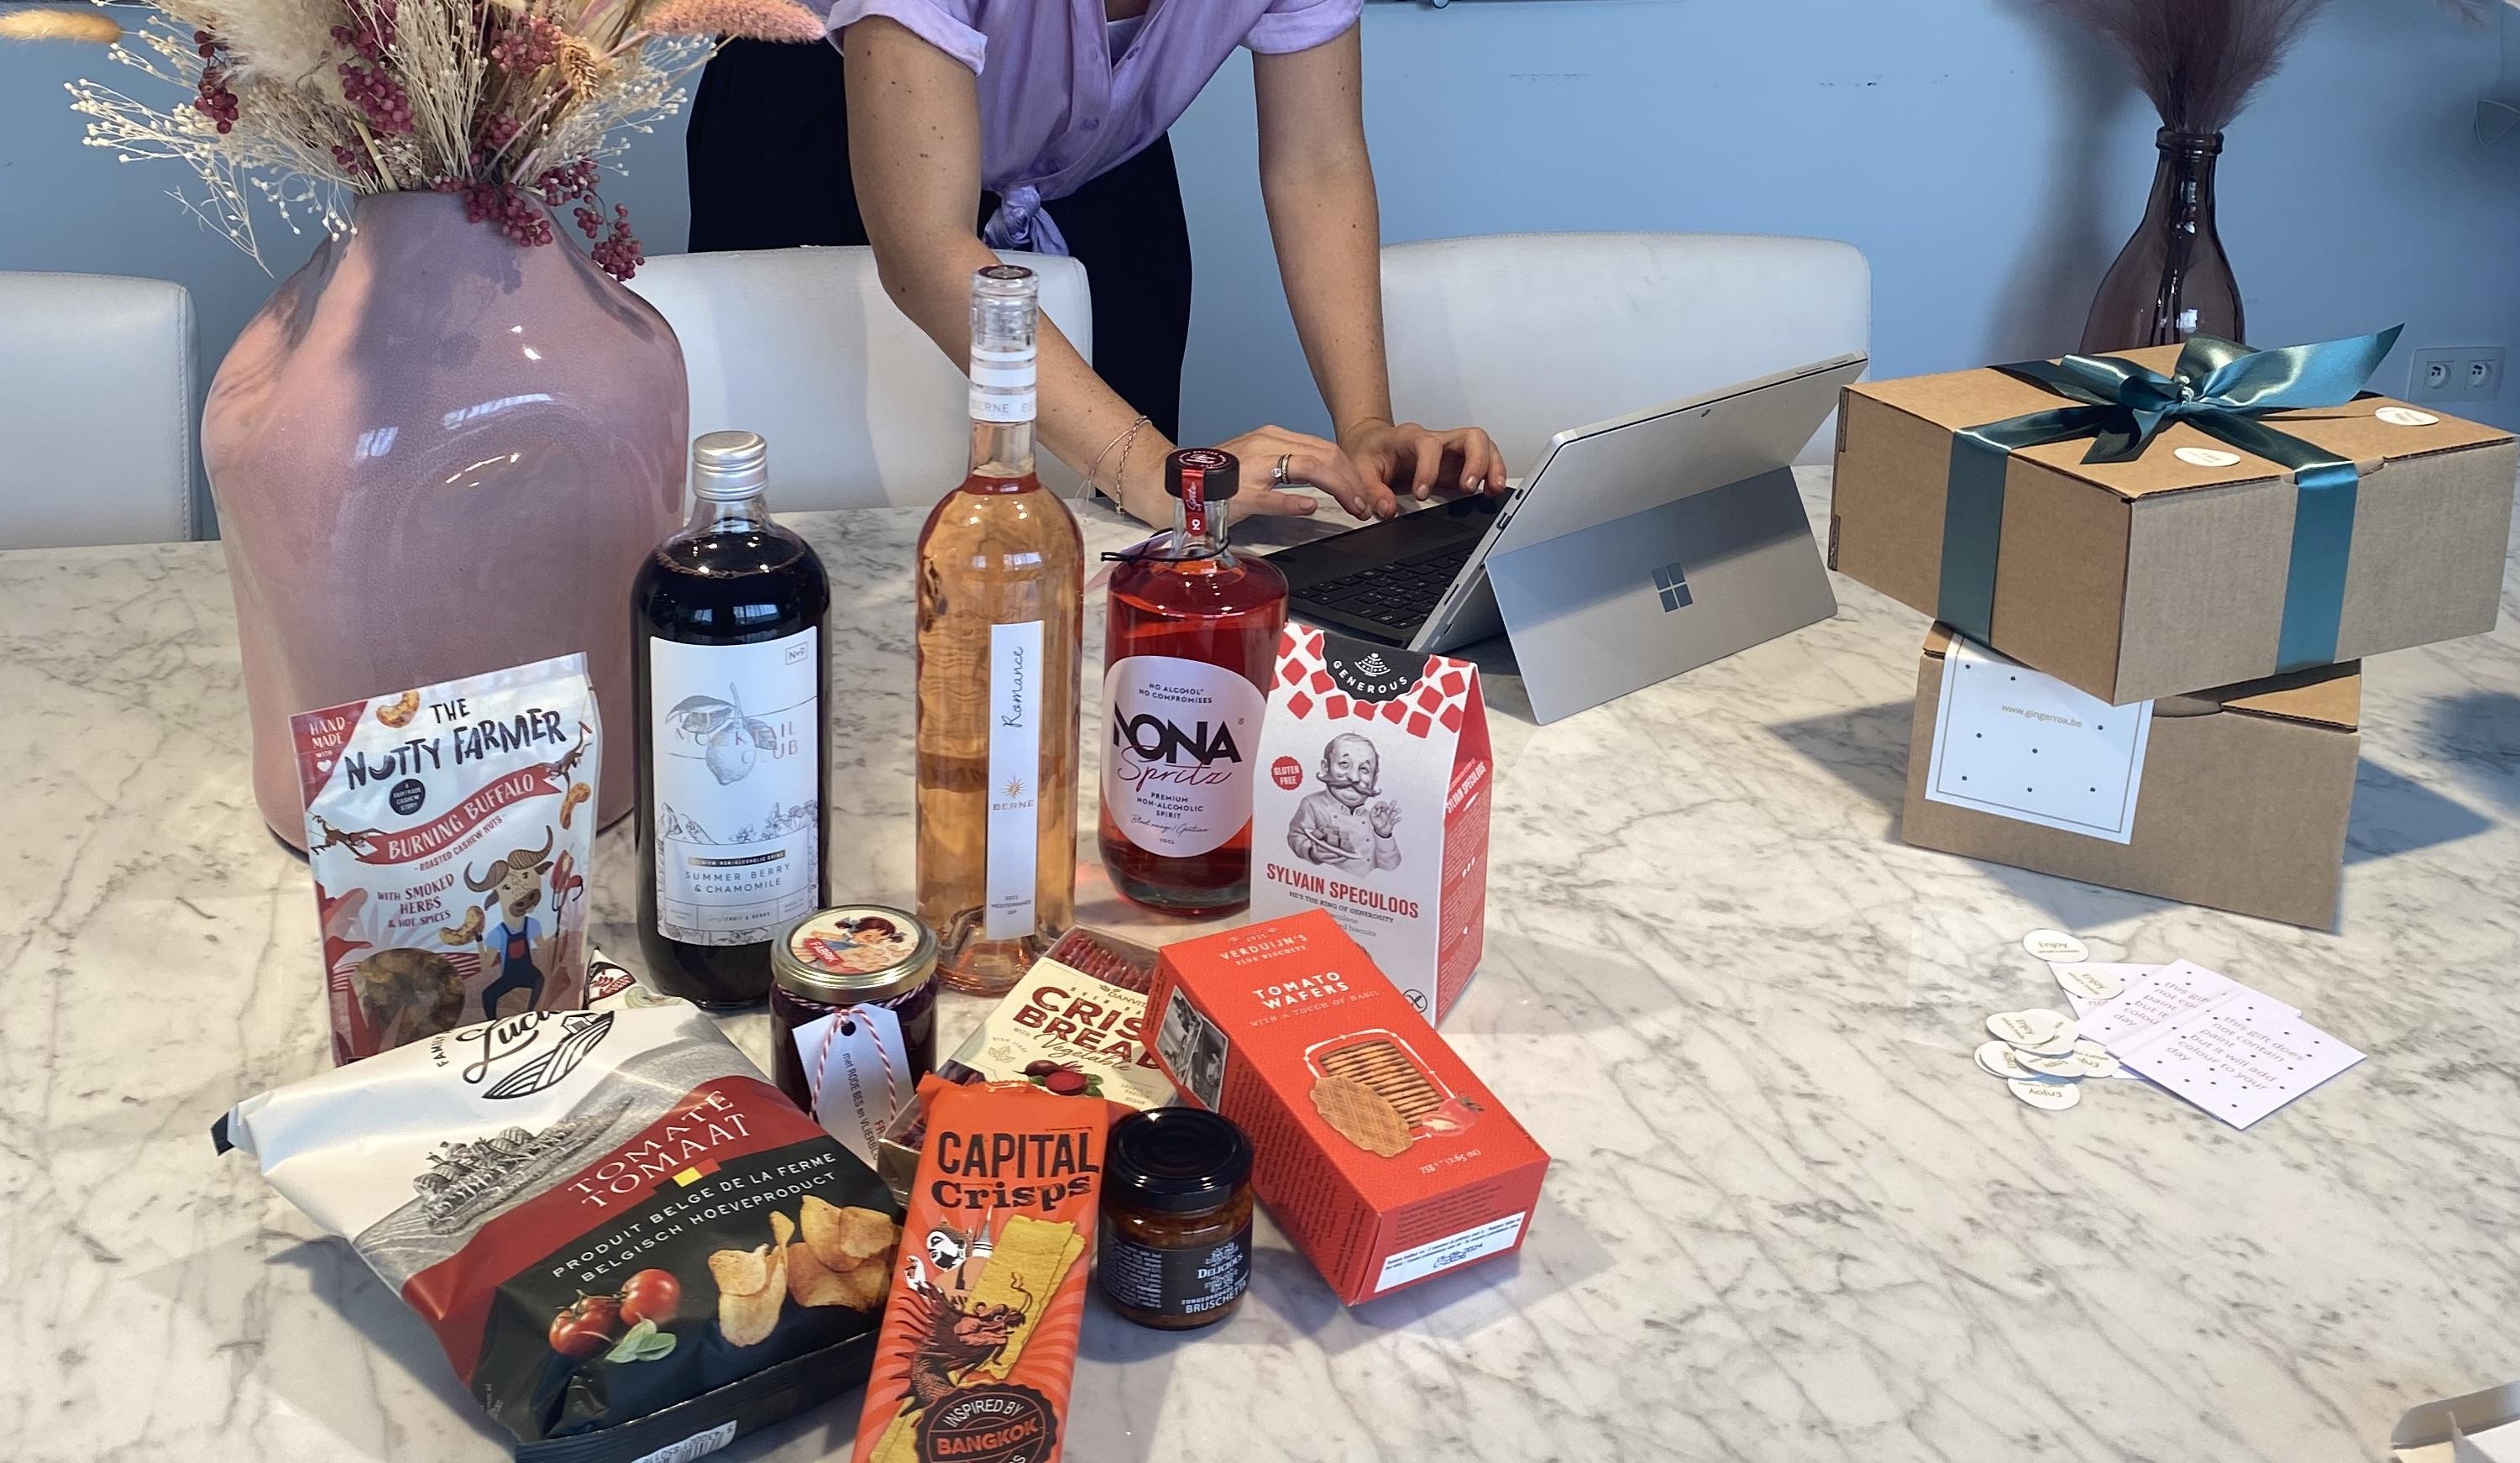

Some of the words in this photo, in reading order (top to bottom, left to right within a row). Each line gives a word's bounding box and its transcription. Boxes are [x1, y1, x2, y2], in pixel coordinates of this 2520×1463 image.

[1001, 646, 1024, 728] Romance
[1149, 683, 1161, 691] NO
[1333, 660, 1407, 694] GENEROUS
[1139, 689, 1150, 697] NO
[1152, 693, 1213, 705] COMPROMISES
[430, 699, 471, 724] THE
[2002, 705, 2083, 727] www.gingerrox.be
[309, 716, 352, 736] HAND-
[312, 732, 344, 748] MADE
[344, 738, 441, 790] NUTTY
[453, 709, 567, 765] FARMER
[1118, 745, 1233, 792] Spritz
[1273, 765, 1300, 776] GLUTEN
[1280, 775, 1297, 785] FREE
[993, 800, 1035, 810] BERNE
[1137, 797, 1203, 812] NON-ALCOHOLIC
[1151, 792, 1188, 802] PREMIUM
[387, 814, 465, 860] BURNING
[464, 773, 535, 821] BUFFALO
[1156, 810, 1181, 819] SPIRIT
[419, 852, 453, 872] ROASTED
[453, 830, 484, 857] CASHEW
[484, 815, 503, 833] NUTS
[684, 871, 741, 881] SUMMER
[751, 863, 791, 878] BERRY
[377, 891, 401, 901] WITH
[406, 873, 454, 900] SMOKED
[694, 884, 702, 893] &
[705, 878, 782, 894] CHAMOMILE
[1266, 863, 1324, 894] SYLVAIN
[1329, 881, 1419, 919] SPECULOOS
[400, 896, 443, 915] HERBS
[421, 910, 451, 925] SPICES
[1305, 895, 1319, 905] THE
[1319, 899, 1338, 910] KING
[1349, 908, 1394, 923] GENEROSITY
[1218, 934, 1307, 960] VERDUIJN'S
[1252, 972, 1341, 1000] TOMATO
[1262, 981, 1349, 1009] WAFERS
[2154, 988, 2177, 1000] not
[2178, 999, 2198, 1008] co
[2165, 982, 2187, 994] this
[1108, 991, 1146, 1008] DANVIT
[1250, 1015, 1278, 1028] WITH
[1279, 1013, 1291, 1021] A
[1292, 1002, 1329, 1016] TOUCH
[1332, 998, 1346, 1006] OF
[1349, 989, 1381, 1003] BASIL
[2134, 1000, 2157, 1012] but
[2142, 994, 2177, 1010] paint
[1032, 987, 1145, 1041] CRIS
[2114, 1014, 2138, 1026] day
[2124, 1007, 2160, 1025] colou
[1013, 1027, 1031, 1037] WITH
[2199, 1029, 2235, 1047] paint
[2212, 1023, 2235, 1036] not
[2236, 1035, 2285, 1062] contain
[2224, 1016, 2247, 1031] this
[2246, 1030, 2271, 1043] gift
[2271, 1041, 2304, 1061] does
[842, 1052, 854, 1068] met
[1034, 1033, 1131, 1071] Vegetable
[2166, 1046, 2191, 1062] day
[2189, 1034, 2213, 1048] but
[2225, 1053, 2250, 1067] will
[2249, 1066, 2277, 1083] add
[2178, 1041, 2220, 1063] colour
[2220, 1062, 2235, 1072] to
[2234, 1072, 2270, 1090] your
[847, 1067, 861, 1092] RODE
[852, 1090, 865, 1108] BES
[2029, 1088, 2062, 1099] Enjoy
[567, 1090, 735, 1193] TOMATE
[860, 1117, 878, 1161] VLIERBLO
[581, 1113, 750, 1208] TOMAAT
[937, 1131, 1100, 1178] CAPITAL
[931, 1175, 1092, 1212] Crisps
[553, 1224, 642, 1277] PRODUIT
[650, 1186, 715, 1224] BELGE
[719, 1177, 746, 1192] DE
[752, 1169, 773, 1185] LA
[776, 1152, 837, 1178] FERME
[581, 1224, 684, 1282] BELGISCH
[689, 1172, 837, 1225] HOEVEPRODUCT
[943, 1399, 1003, 1428] INSPIRED
[1003, 1401, 1024, 1417] BY
[936, 1417, 1039, 1455] BANGKOK
